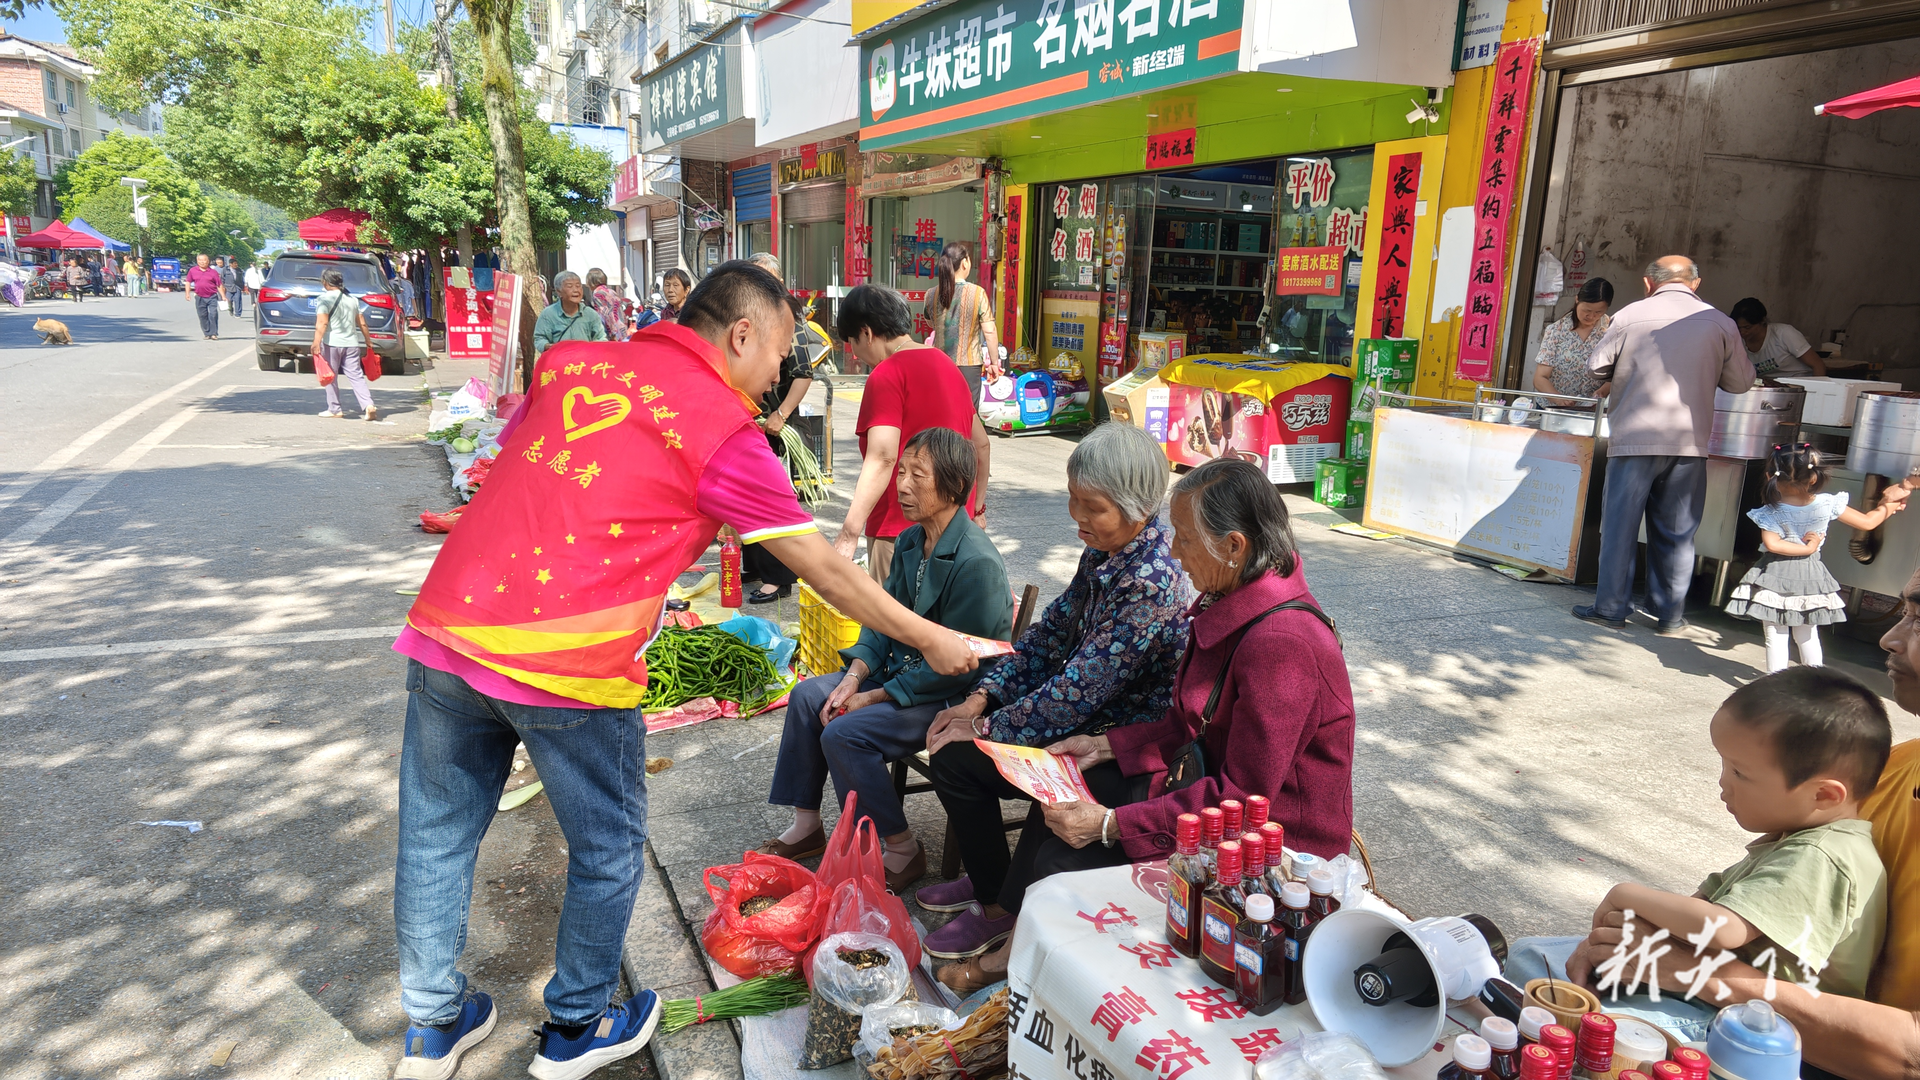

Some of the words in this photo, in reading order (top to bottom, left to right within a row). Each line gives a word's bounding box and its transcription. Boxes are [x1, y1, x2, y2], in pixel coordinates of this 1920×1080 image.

[899, 6, 1017, 106] 牛妹超市
[1055, 186, 1097, 217] 名烟
[1288, 162, 1333, 205] 平价
[915, 218, 937, 279] 推门
[1052, 231, 1094, 260] 名酒
[1282, 254, 1339, 272] 宴席酒水配送
[1282, 278, 1322, 287] 18173399968
[466, 289, 479, 324] 咨询点
[1281, 401, 1331, 432] 巧乐兹
[522, 435, 602, 489] 志愿者
[723, 560, 733, 597] 王老吉
[1090, 985, 1211, 1080] 膏药
